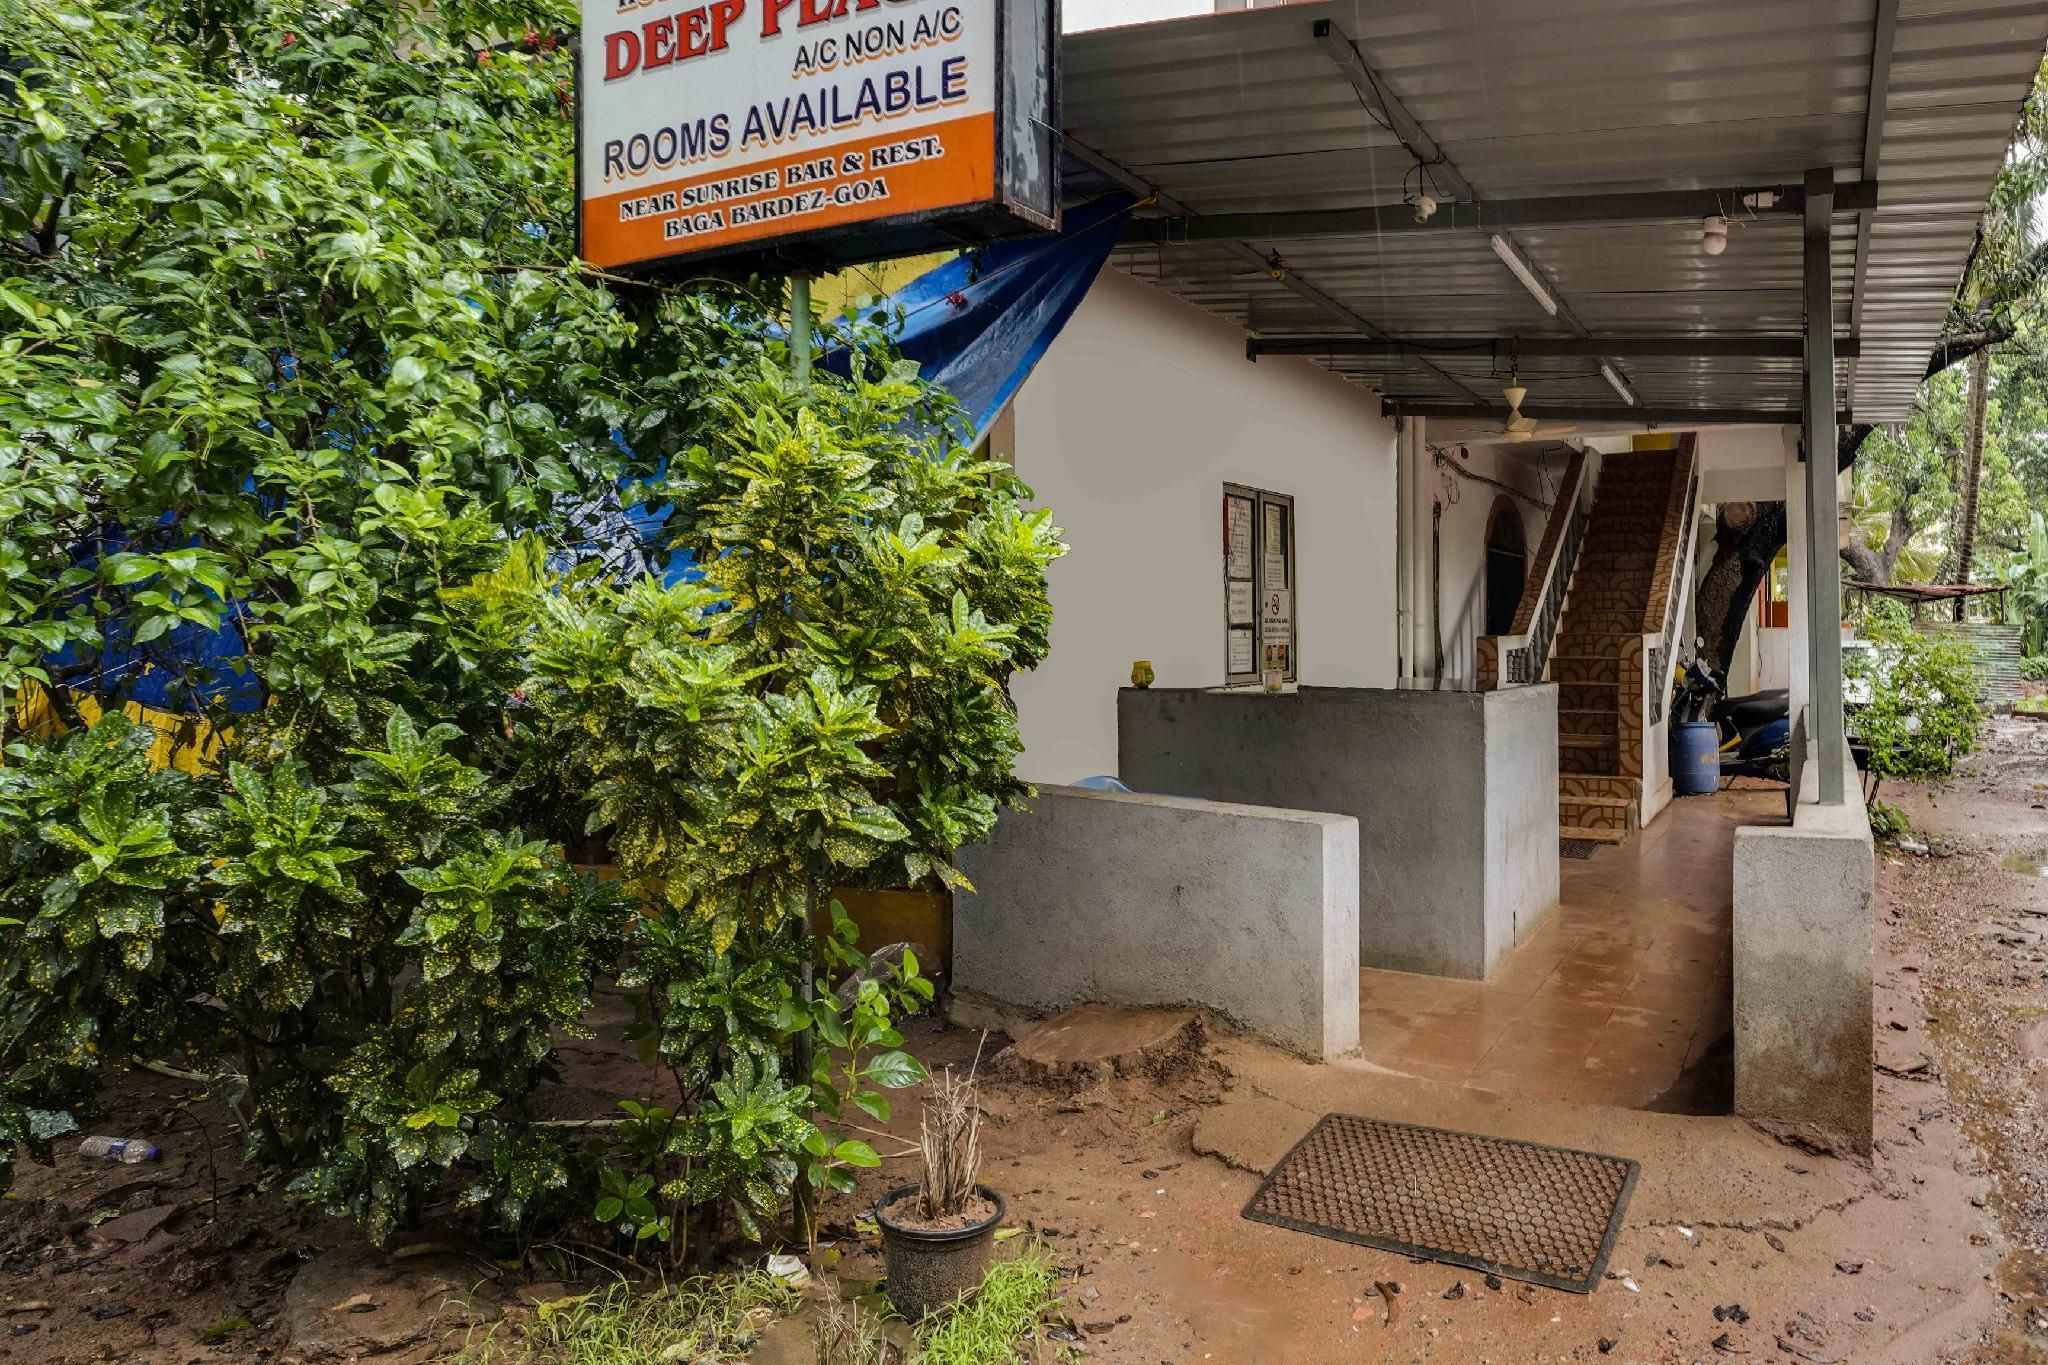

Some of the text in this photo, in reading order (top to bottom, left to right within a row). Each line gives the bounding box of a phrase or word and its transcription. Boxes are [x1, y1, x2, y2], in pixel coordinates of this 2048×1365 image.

[603, 0, 746, 82] DEEP
[793, 6, 962, 75] A/C NON A/C
[604, 55, 967, 180] ROOMS AVAILABLE
[619, 136, 945, 221] NEAR SUNRISE BAR & REST.
[664, 177, 889, 241] BAGA BARDEZ-GOA
